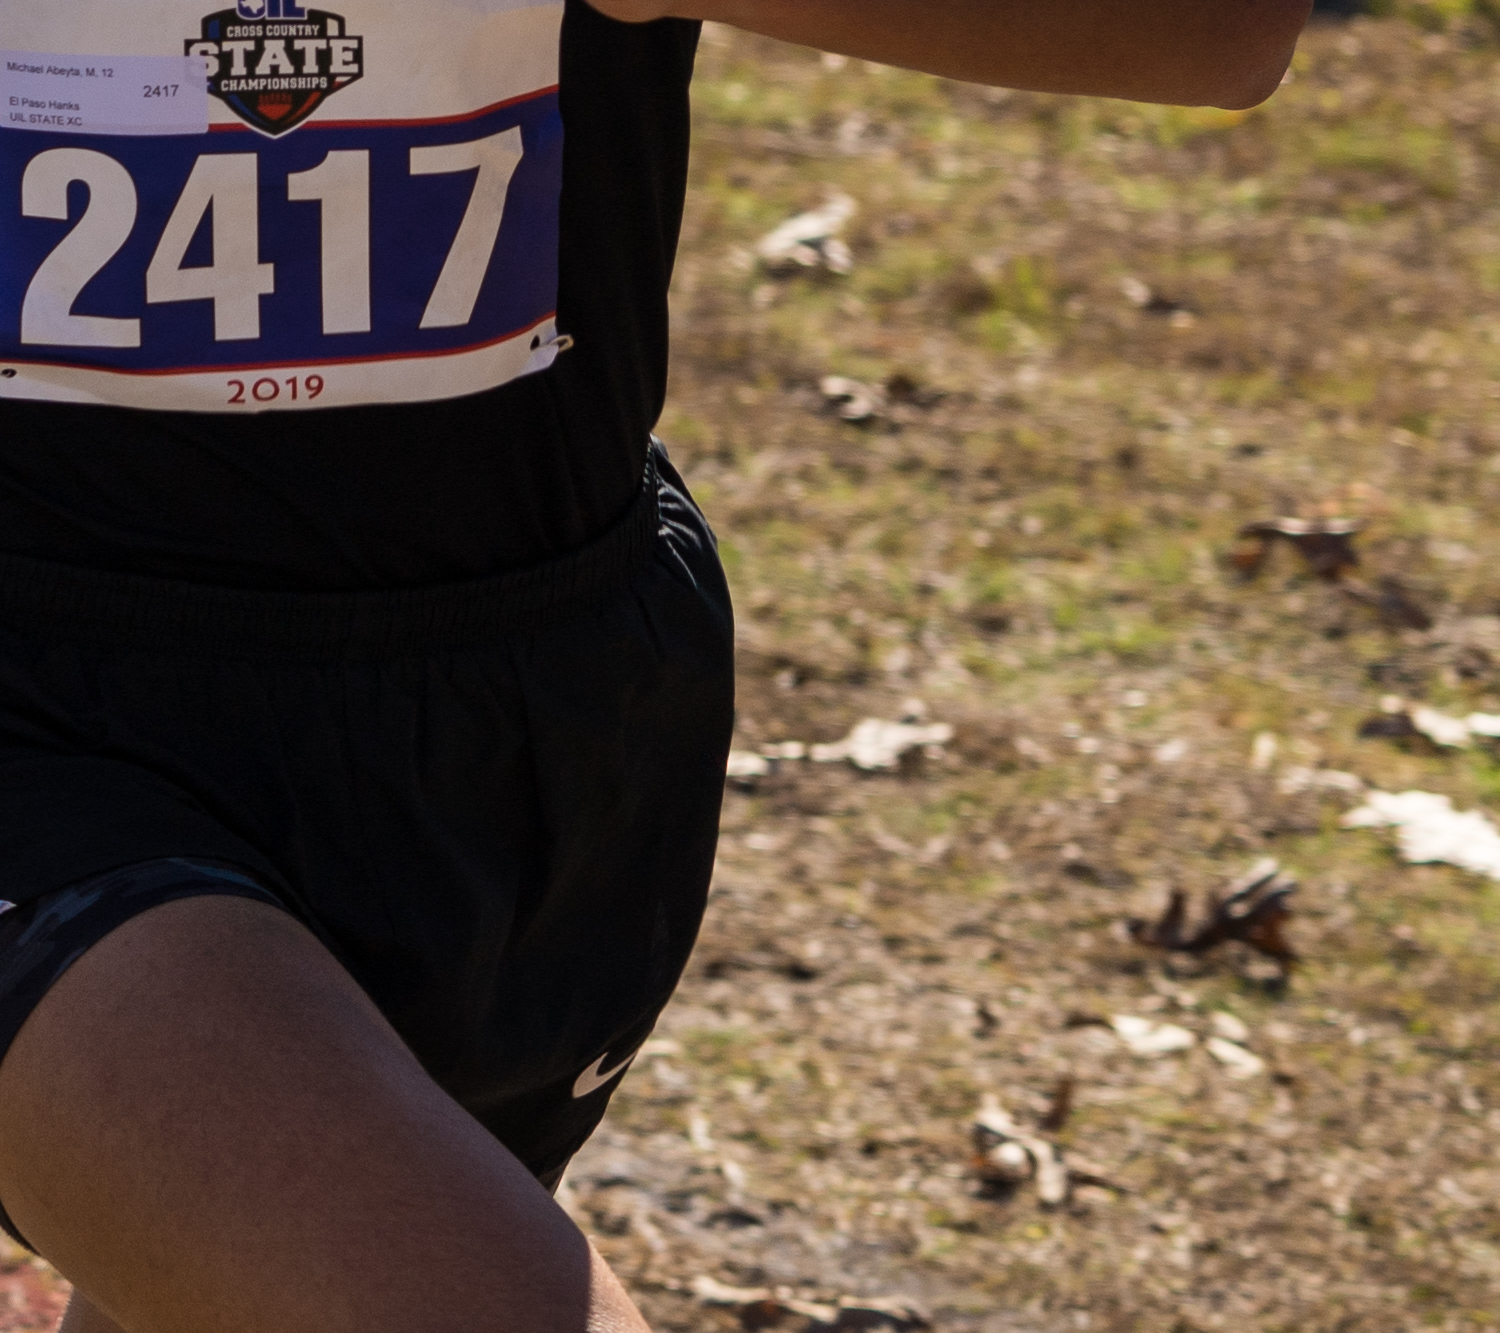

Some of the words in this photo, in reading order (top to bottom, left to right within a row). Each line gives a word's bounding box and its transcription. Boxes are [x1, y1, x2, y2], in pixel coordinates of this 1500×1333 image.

[226, 25, 263, 38] CROSS
[266, 24, 321, 37] COUNTRY
[188, 38, 359, 78] STATE
[6, 61, 44, 74] Michael
[102, 68, 114, 78] 12
[142, 84, 180, 98] 2417
[220, 76, 328, 92] CHAMPIONSHIPS
[9, 96, 19, 106] El
[21, 97, 46, 109] Paso
[49, 99, 80, 111] Hanks
[9, 112, 26, 123] UIL
[29, 113, 64, 125] STATE
[67, 116, 83, 127] XC
[20, 125, 524, 348] 2417
[225, 374, 325, 404] 2019
